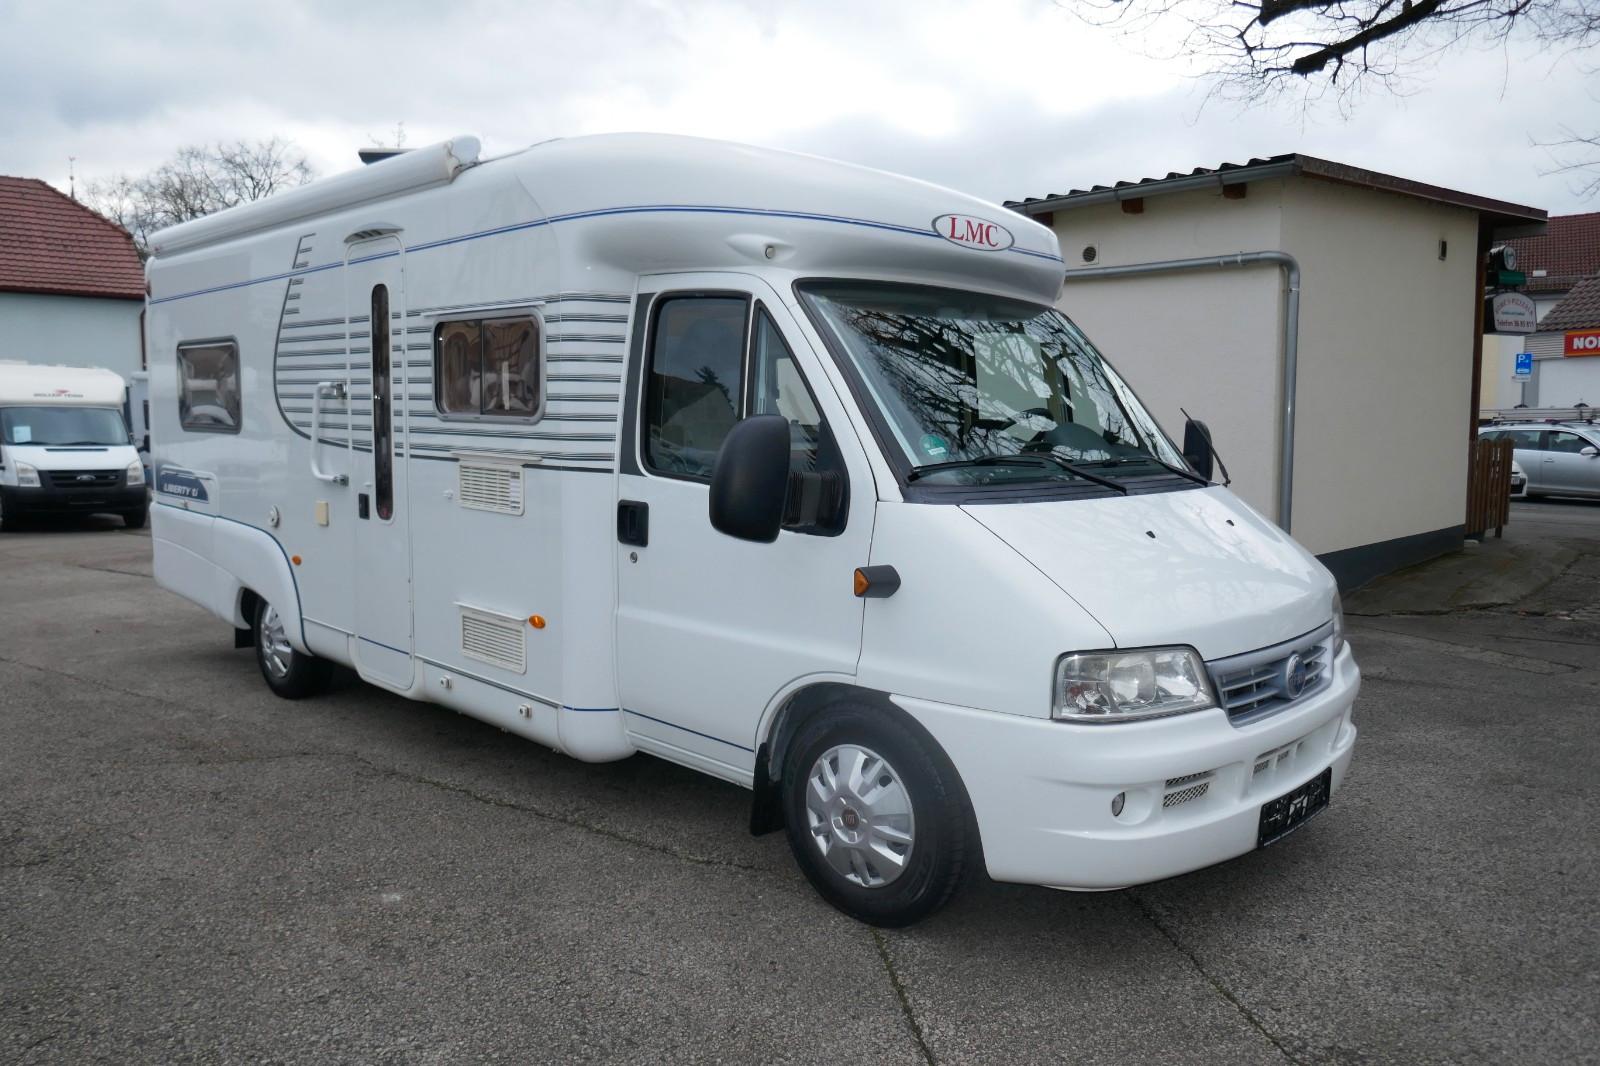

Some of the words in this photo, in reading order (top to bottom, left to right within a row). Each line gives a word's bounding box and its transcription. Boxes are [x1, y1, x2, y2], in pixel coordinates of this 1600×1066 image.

[948, 216, 999, 248] LMC
[1573, 336, 1600, 350] NO
[1518, 355, 1526, 363] P
[163, 483, 191, 496] LIBERTY
